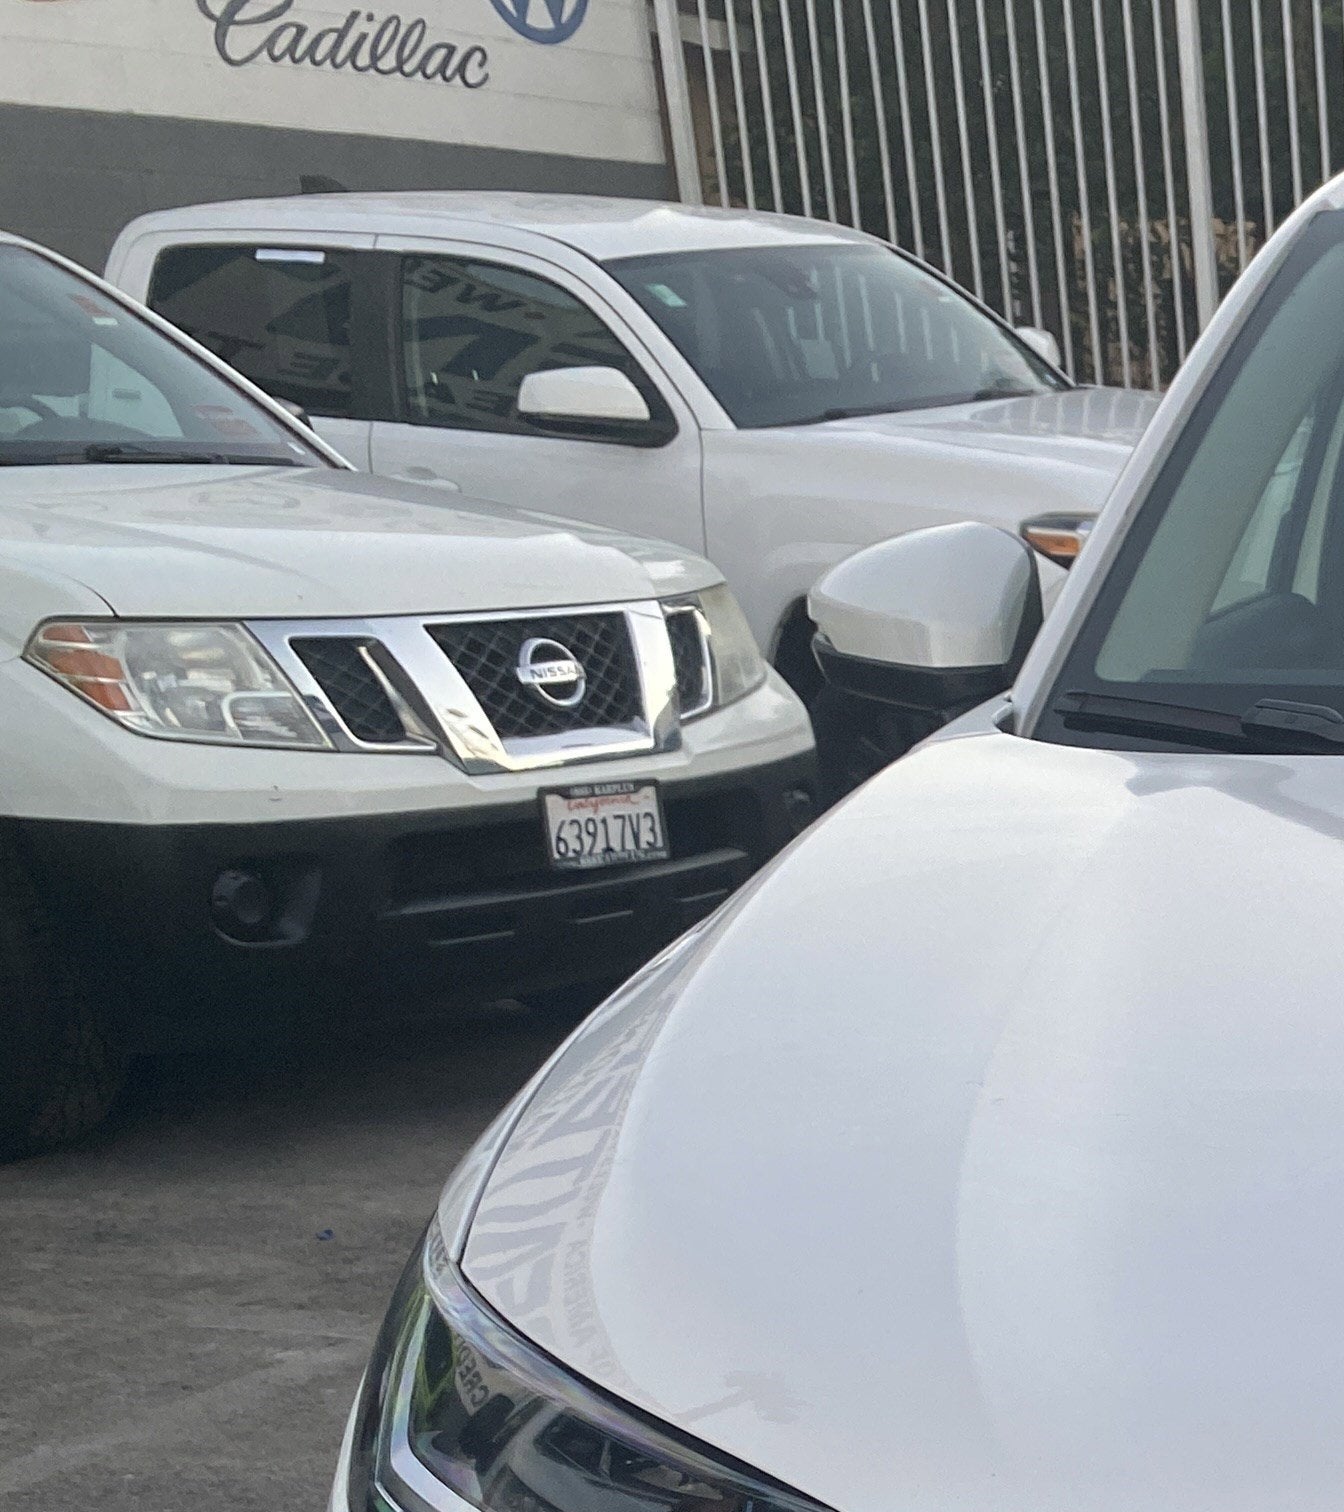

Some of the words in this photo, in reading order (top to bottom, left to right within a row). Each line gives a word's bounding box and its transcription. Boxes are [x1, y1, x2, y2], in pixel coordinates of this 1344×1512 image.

[197, 0, 489, 89] Cadillac
[529, 664, 582, 680] NISSAN
[555, 811, 658, 857] 63917V3
